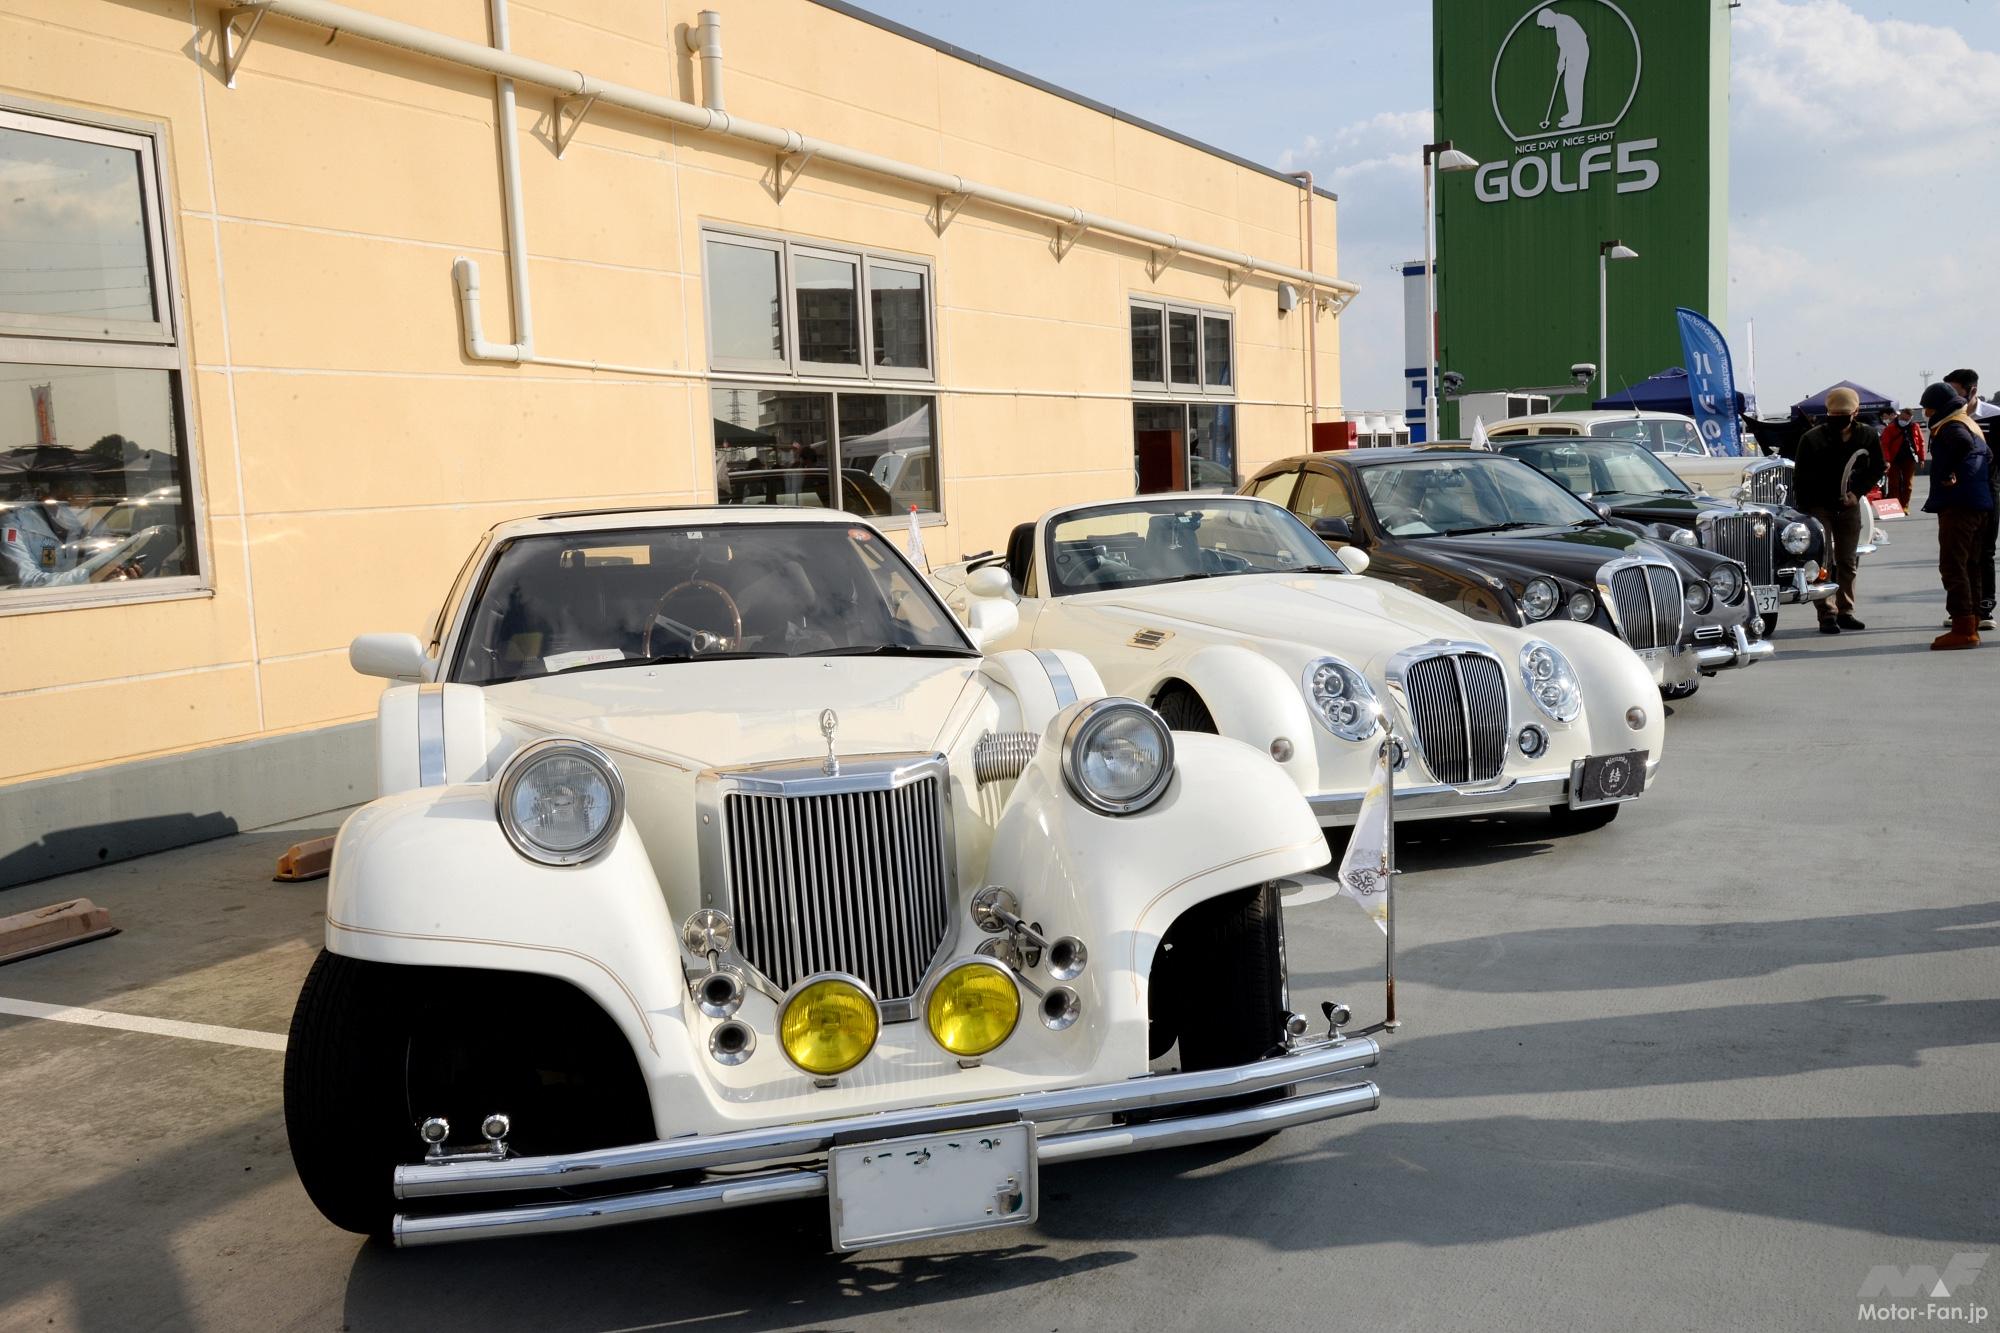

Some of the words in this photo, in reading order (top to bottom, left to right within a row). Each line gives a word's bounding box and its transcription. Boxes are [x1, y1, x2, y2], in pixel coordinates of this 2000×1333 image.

[1514, 143, 1538, 155] NICE
[1538, 139, 1559, 152] DAY
[1562, 135, 1586, 148] NICE
[1588, 130, 1616, 144] SHOT
[1759, 597, 1776, 610] -37
